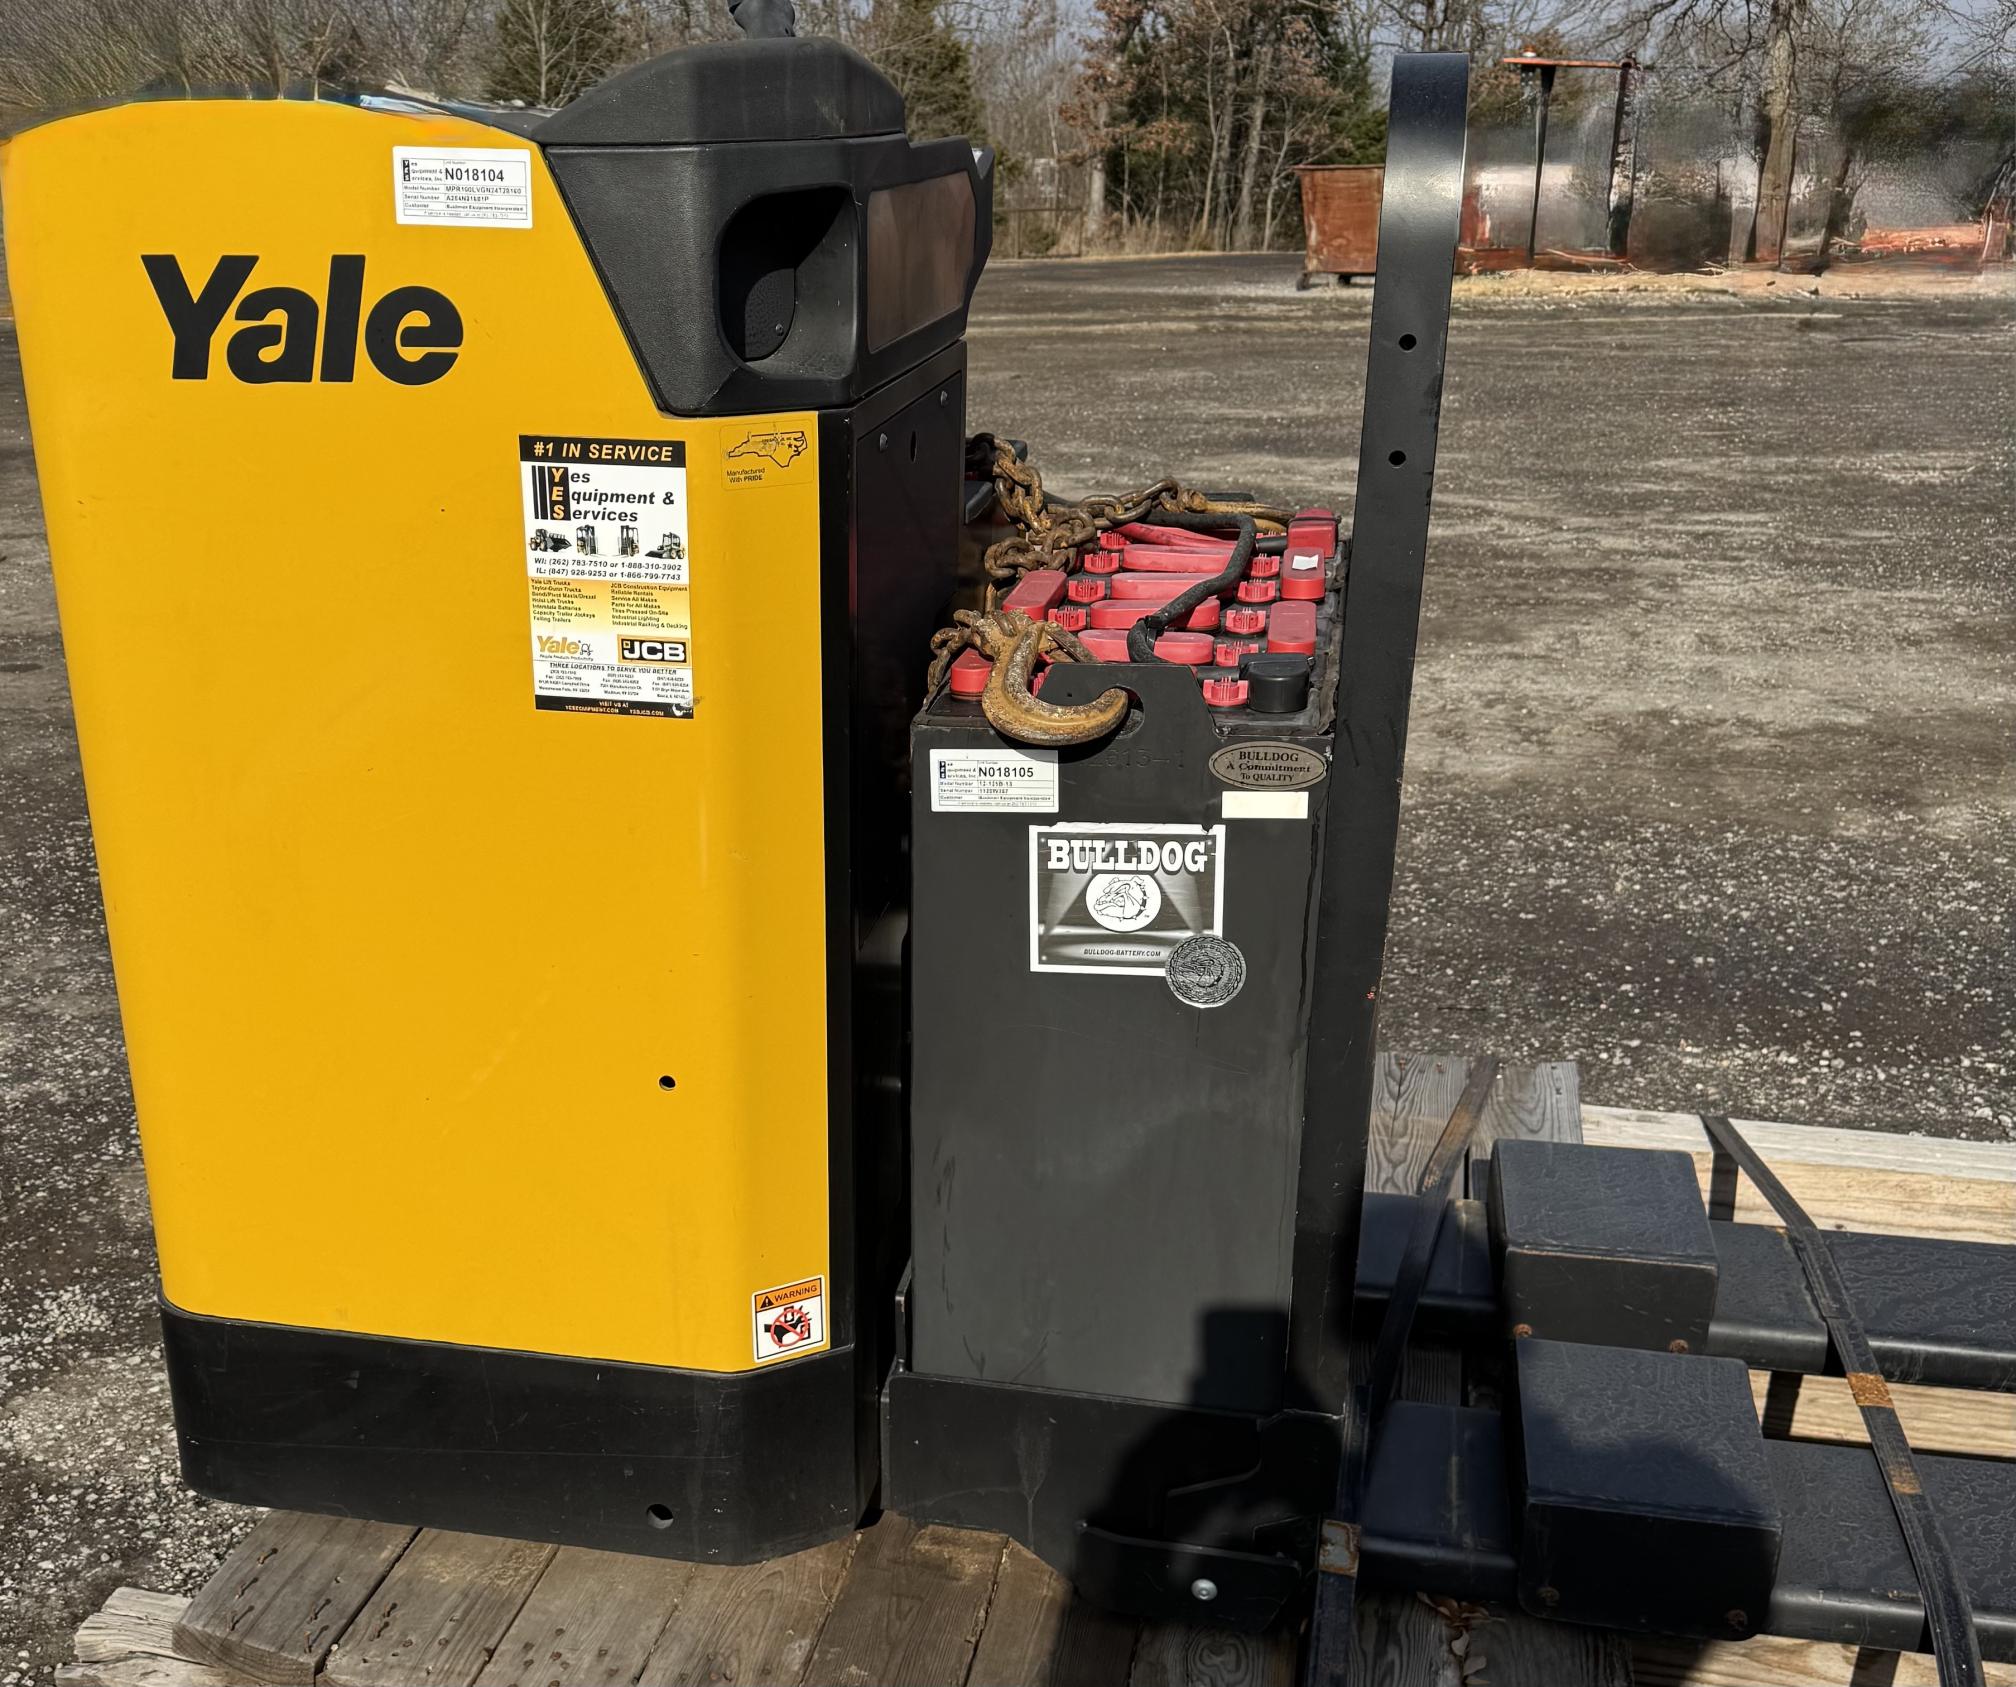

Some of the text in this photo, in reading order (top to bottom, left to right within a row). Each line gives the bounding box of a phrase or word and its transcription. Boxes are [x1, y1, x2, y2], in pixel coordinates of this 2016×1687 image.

[445, 167, 504, 182] N018104
[140, 254, 464, 386] Yale
[534, 442, 673, 462] #1 IN SERVICE
[726, 468, 765, 477] Manufactured
[662, 492, 675, 505] &
[549, 558, 569, 567] (262)
[572, 560, 607, 568] 783-7510
[548, 568, 568, 576] (847)
[571, 569, 607, 577] 928-9253
[621, 572, 680, 580] 1-866-799-7743
[537, 636, 580, 654] Yale
[623, 640, 685, 662] JCB
[1239, 751, 1299, 762] BULLDOG
[979, 767, 1034, 778] N018105
[1226, 761, 1311, 773] A Commitment
[1253, 773, 1295, 782] QUALITY
[1047, 838, 1208, 874] BULLDOG
[1083, 949, 1161, 958] BULLDOG-BATTERY.COM
[774, 1285, 817, 1302] WARNING
